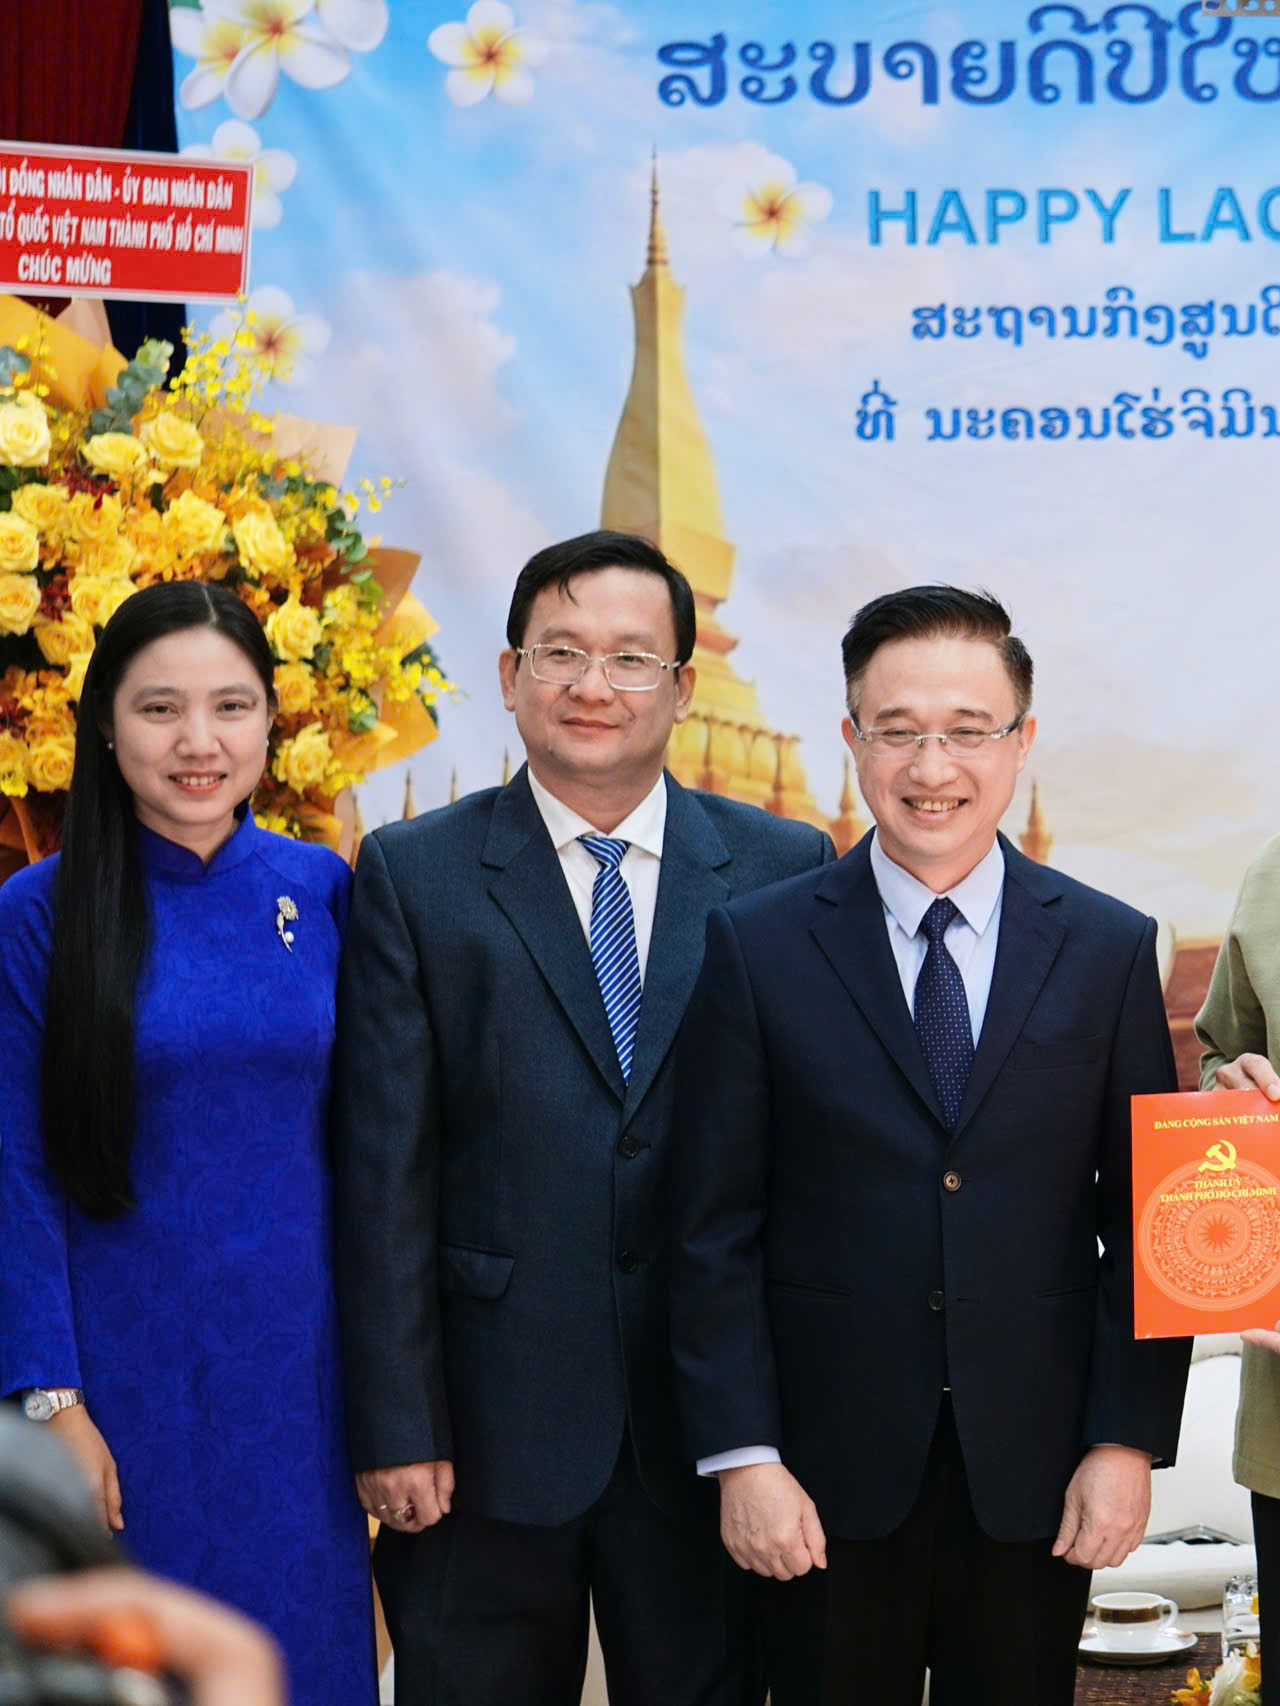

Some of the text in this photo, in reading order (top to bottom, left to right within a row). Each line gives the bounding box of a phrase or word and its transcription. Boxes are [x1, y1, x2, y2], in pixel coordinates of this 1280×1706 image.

[142, 176, 169, 207] BAN
[80, 215, 107, 247] NAM
[868, 187, 1132, 246] HAPPY
[17, 248, 62, 283] CHÚC
